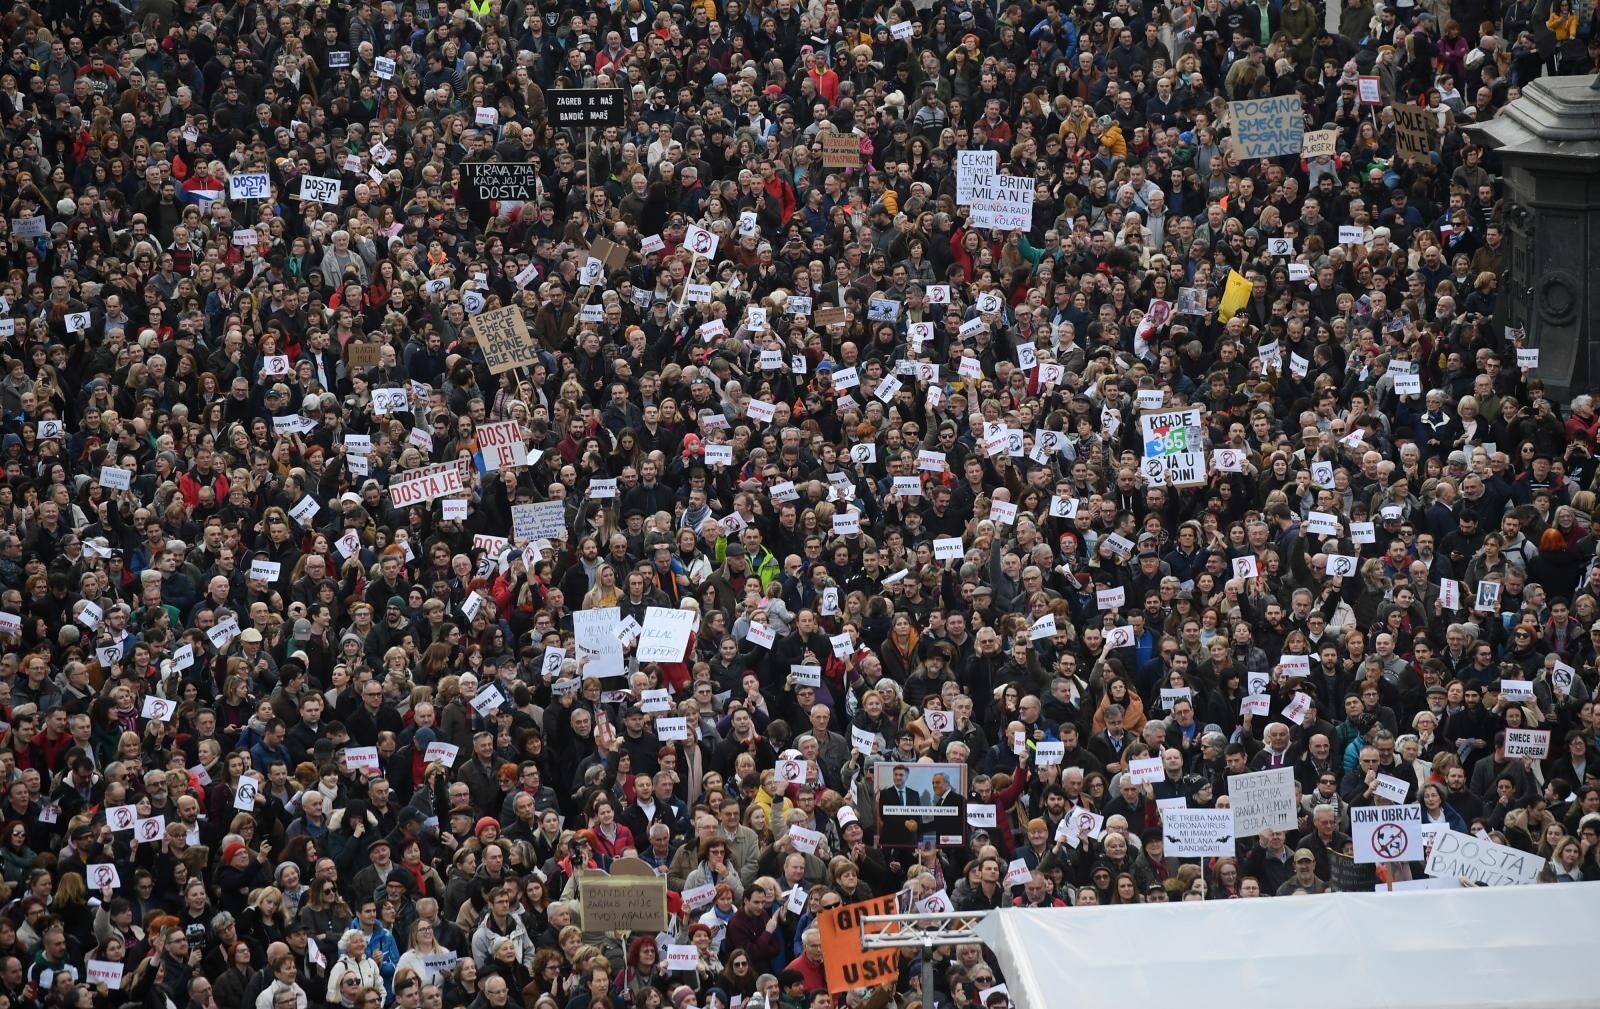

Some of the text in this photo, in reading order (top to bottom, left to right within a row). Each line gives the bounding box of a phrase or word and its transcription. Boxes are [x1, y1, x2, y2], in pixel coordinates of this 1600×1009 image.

[556, 94, 613, 106] ZAGREB JE NAŠ
[560, 110, 608, 120] BANDIĆ MARŠ
[1234, 98, 1300, 118] POGANO
[1238, 115, 1304, 132] SMEĆE IZ
[1393, 108, 1424, 132] DOLE
[1238, 130, 1304, 144] POGANE
[1308, 132, 1328, 142] AJMO
[1398, 132, 1428, 155] MILE
[1246, 142, 1299, 157] VLAKE
[1302, 144, 1334, 154] PURGERI
[962, 154, 993, 166] ČEKAM
[476, 164, 511, 177] KRAVA
[514, 164, 534, 176] ZNA
[233, 176, 268, 190] DOSTA
[305, 179, 338, 193] DOSTA
[474, 175, 535, 186] KADA JOJ JE
[974, 174, 1033, 190] NE BRINI
[240, 186, 263, 197] JE!
[310, 189, 332, 202] JE!
[480, 185, 530, 200] DOSTA
[972, 188, 1030, 204] MILANE
[972, 204, 1030, 214] KOLINDA RADI
[994, 216, 1026, 227] KOLAČE
[476, 307, 515, 326] SKUPLJE
[486, 328, 516, 342] DA BI
[486, 344, 538, 368] BILE VEĆE
[1150, 412, 1193, 429] KRADE
[477, 422, 522, 448] DOSTA
[1154, 431, 1182, 452] 365
[497, 446, 516, 468] JE!
[391, 470, 463, 504] DOSTA JE!
[1509, 731, 1546, 744] SMEĆE VAN
[1508, 745, 1546, 756] IZ ZAGREBA!
[1235, 772, 1285, 791] DOSTA JE
[1246, 788, 1282, 802] TERORA
[1166, 814, 1230, 822] NE TREBA NAMA
[1352, 807, 1421, 824] JOHN OBRAZ
[1178, 844, 1220, 852] BANDIĆA!!!
[1436, 832, 1525, 876] DOSTA
